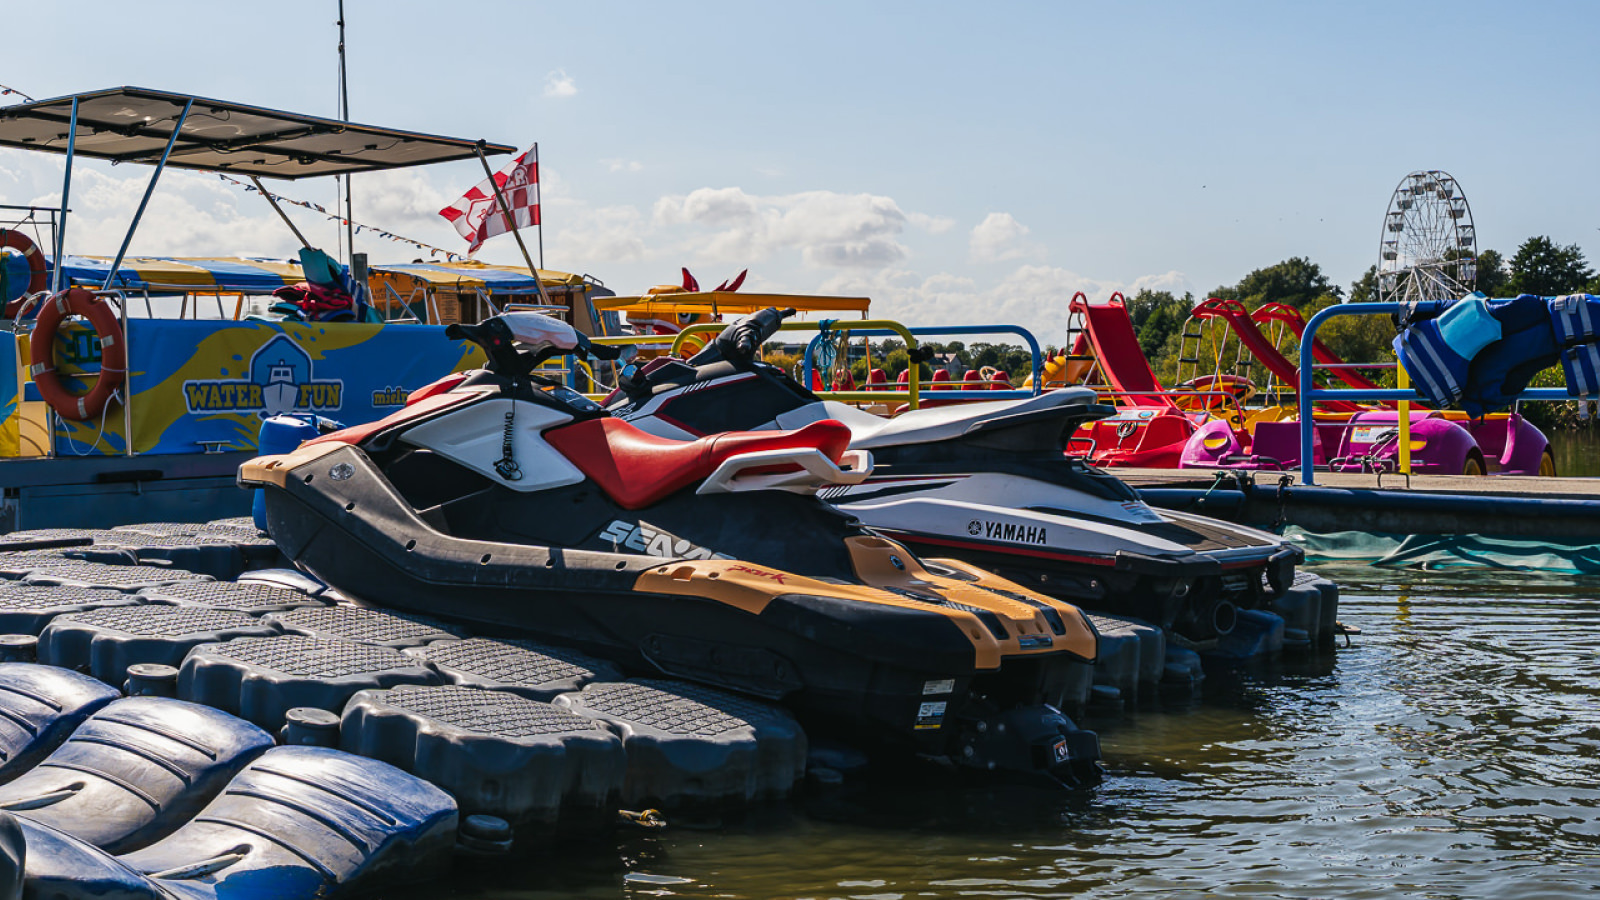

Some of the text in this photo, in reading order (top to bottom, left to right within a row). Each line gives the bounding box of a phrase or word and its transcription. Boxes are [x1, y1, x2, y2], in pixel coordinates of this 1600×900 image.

[187, 384, 341, 408] WATER FUN
[985, 521, 1047, 544] YAMAHA
